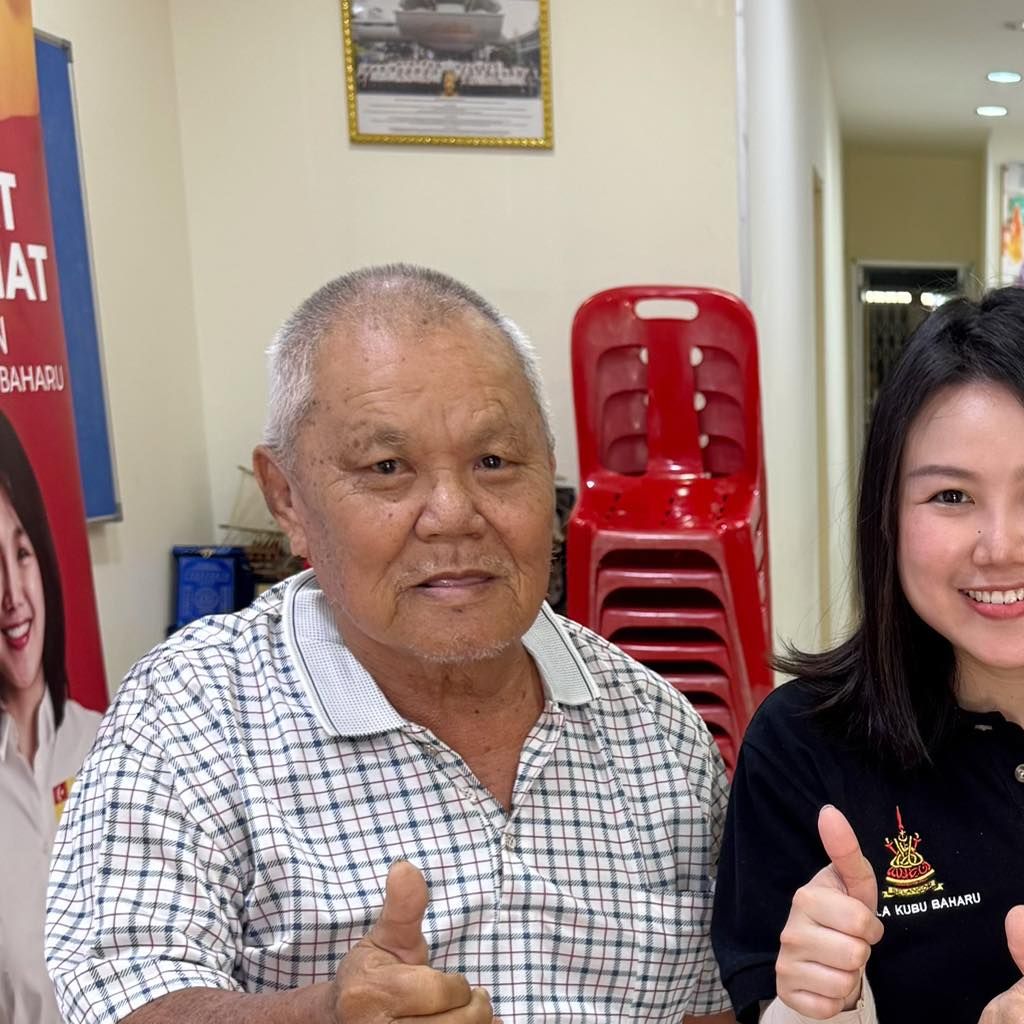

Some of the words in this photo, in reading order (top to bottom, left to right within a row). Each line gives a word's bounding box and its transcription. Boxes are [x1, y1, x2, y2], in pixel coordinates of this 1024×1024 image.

[0, 242, 48, 301] AT
[0, 364, 65, 393] BAHARU
[894, 901, 928, 916] KUBU
[931, 892, 981, 910] BAHARU
